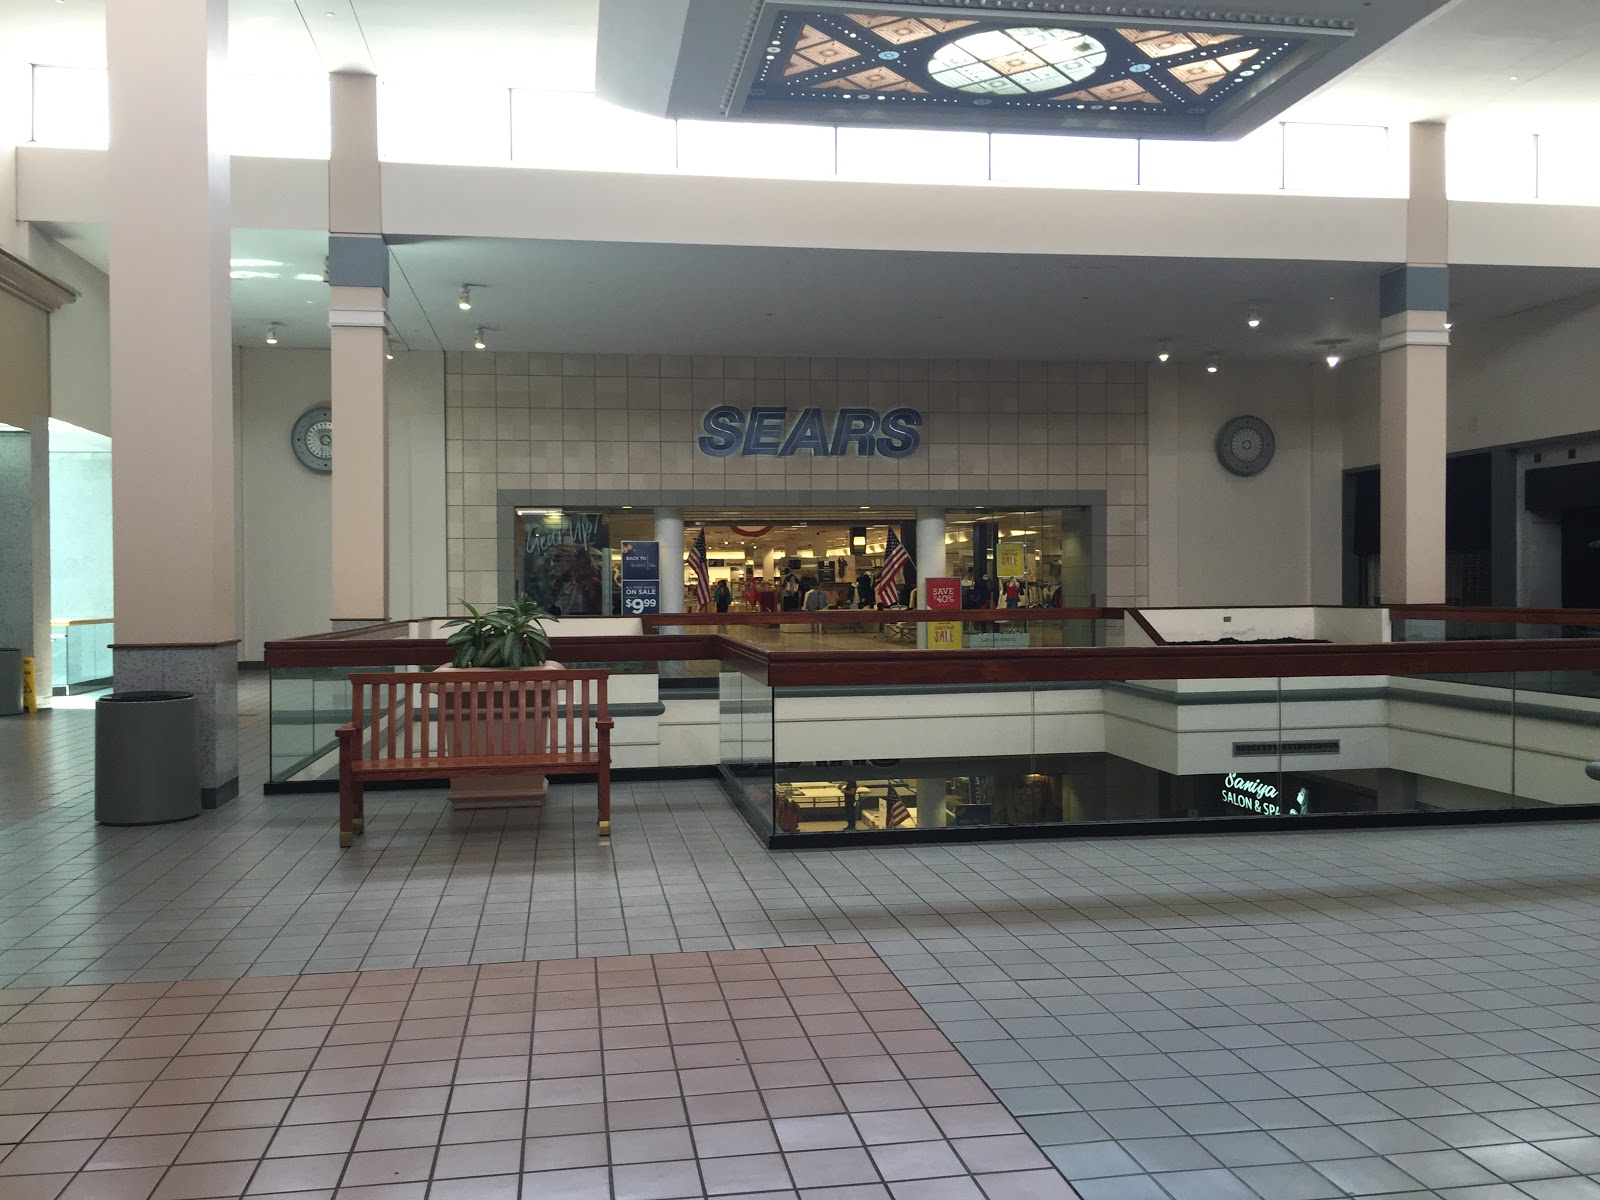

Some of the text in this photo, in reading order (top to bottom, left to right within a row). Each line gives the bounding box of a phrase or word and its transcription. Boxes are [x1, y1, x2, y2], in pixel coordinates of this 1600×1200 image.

[698, 405, 923, 458] SEARS
[1001, 556, 1018, 566] SALE
[932, 587, 954, 596] SAVE
[936, 595, 955, 603] 40%
[933, 630, 954, 643] SALE
[1224, 772, 1280, 799] Saniya
[1221, 789, 1253, 810] SALON
[1254, 799, 1262, 813] &
